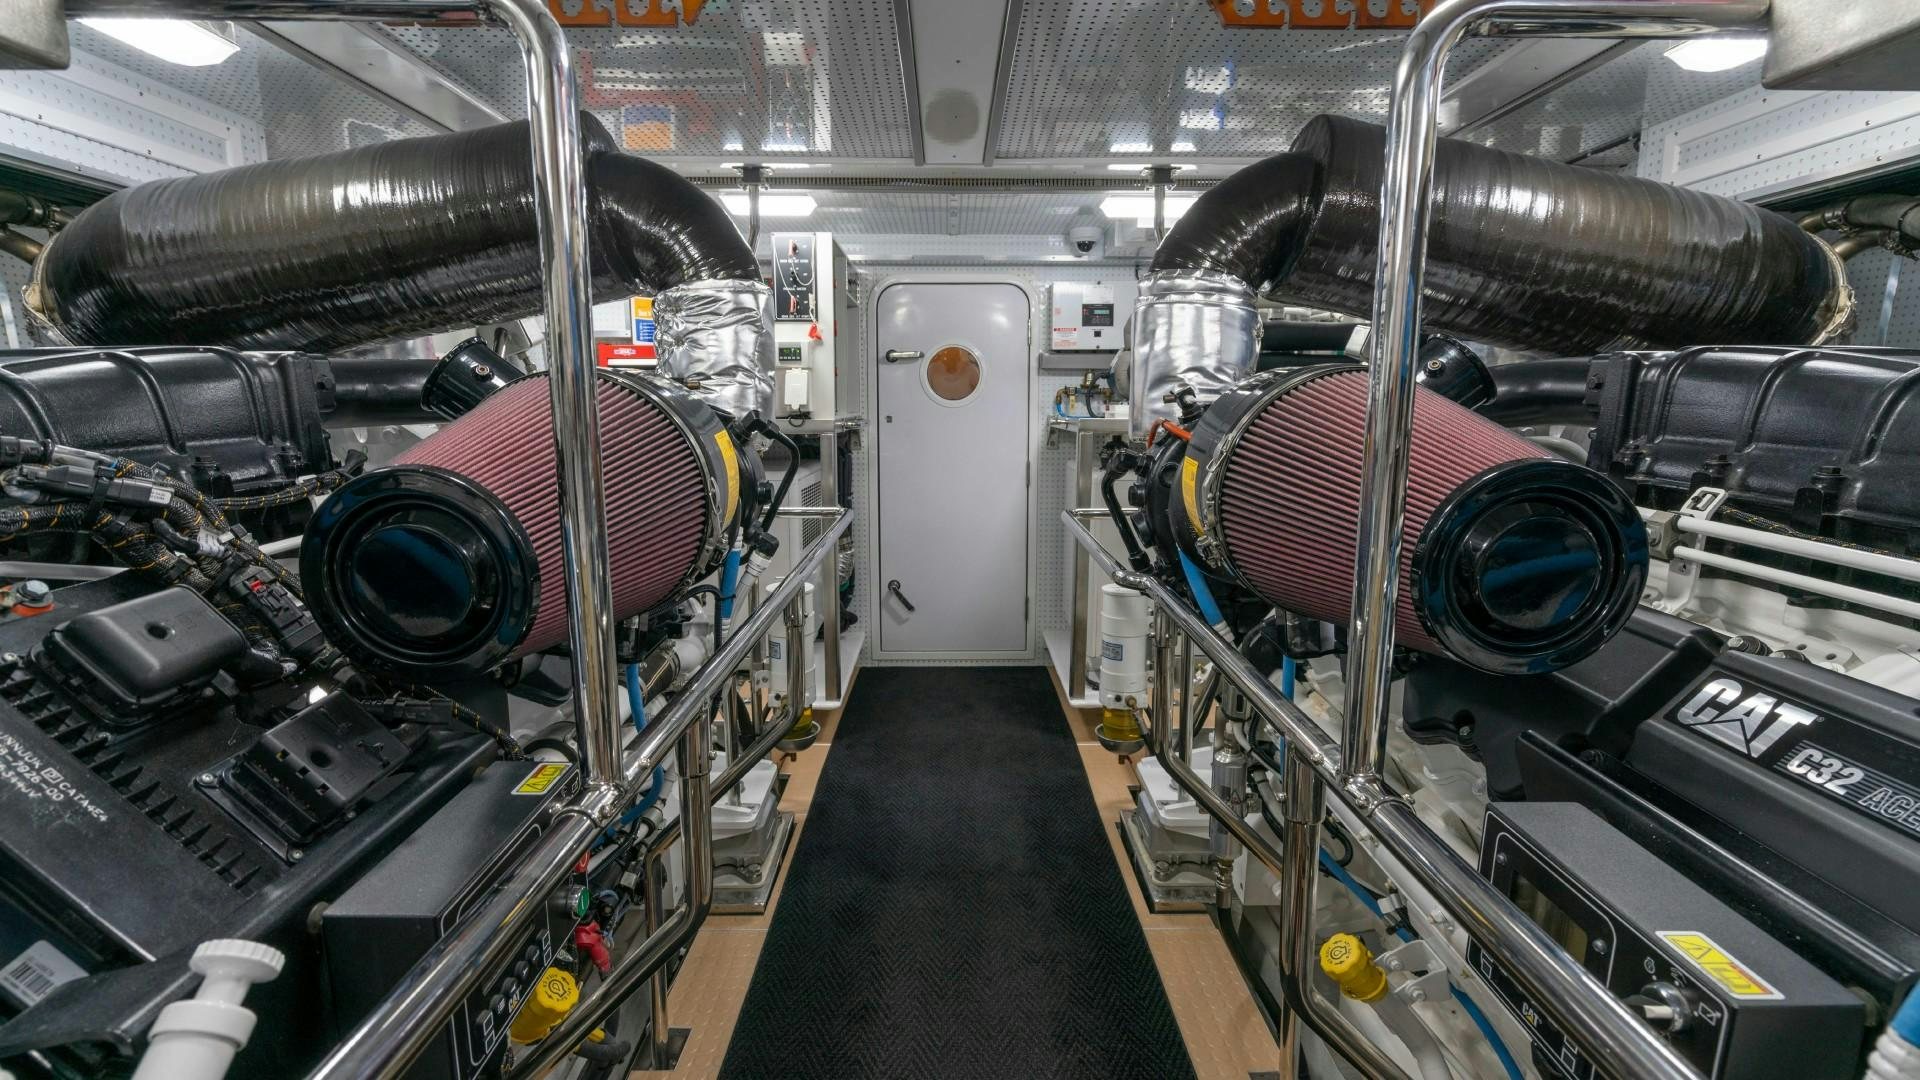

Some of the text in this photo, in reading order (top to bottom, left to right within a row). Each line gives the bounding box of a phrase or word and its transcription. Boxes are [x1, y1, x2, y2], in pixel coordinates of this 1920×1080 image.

[1677, 678, 1818, 758] CAT
[1786, 748, 1865, 796] C32
[1521, 1001, 1540, 1028] CAT
